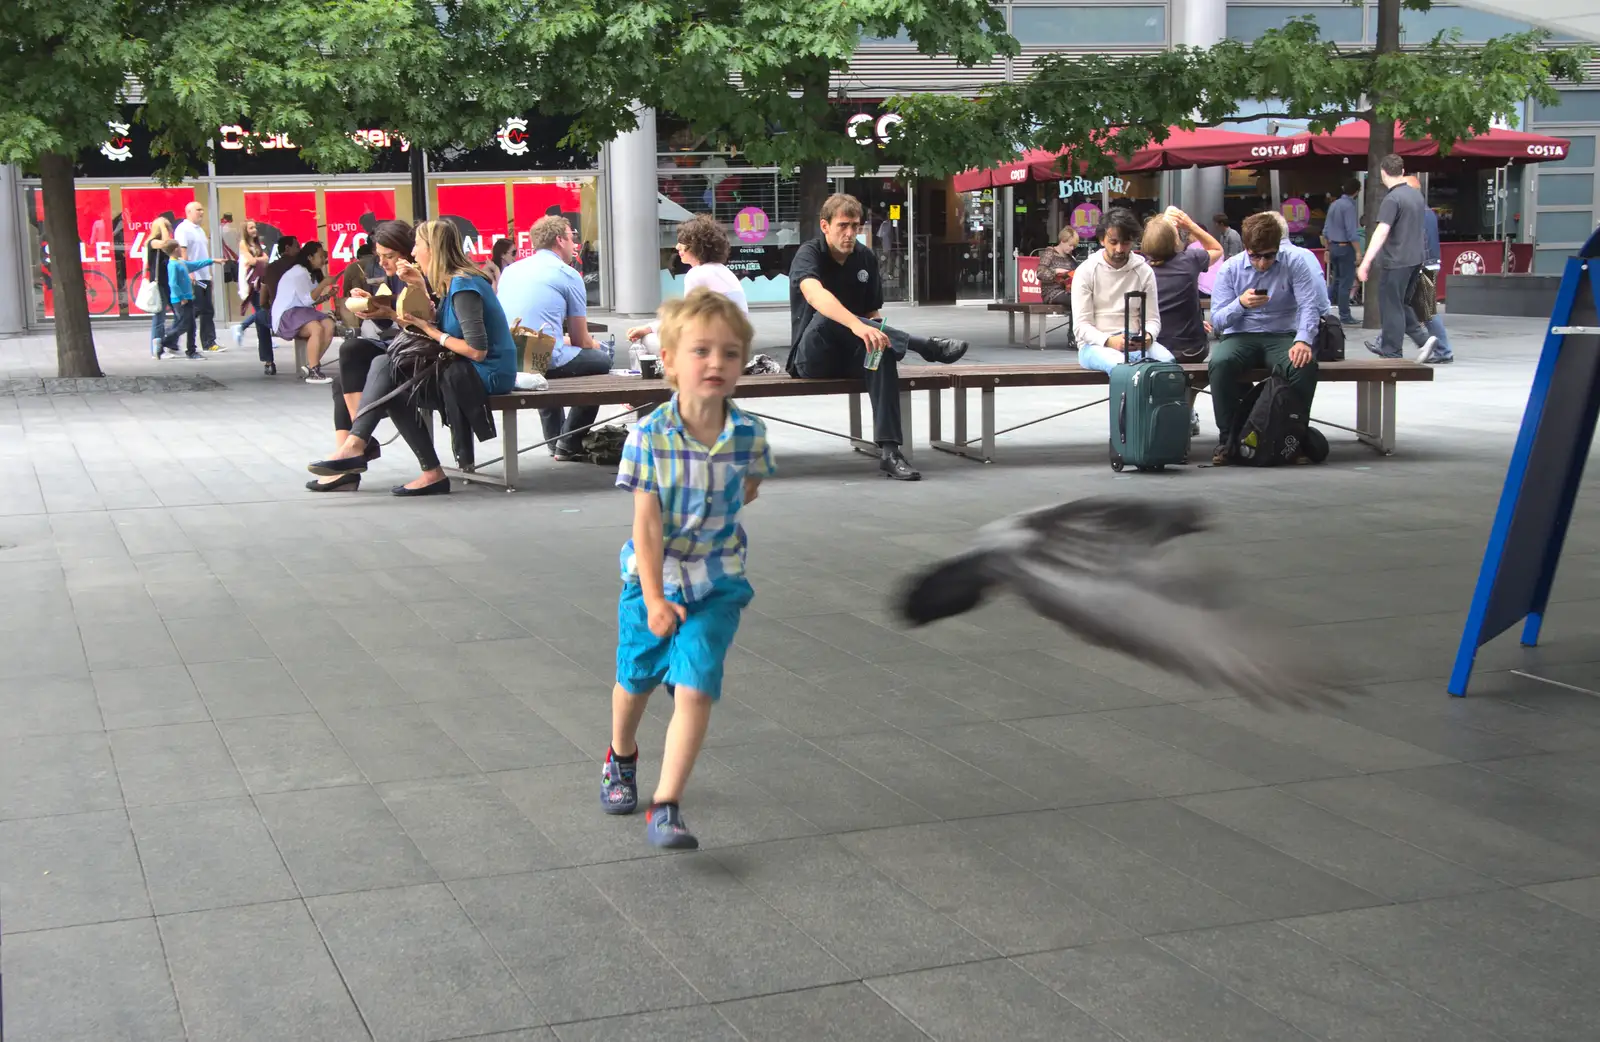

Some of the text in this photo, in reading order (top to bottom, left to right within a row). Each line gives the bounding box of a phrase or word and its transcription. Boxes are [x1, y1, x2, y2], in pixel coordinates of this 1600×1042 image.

[1251, 145, 1288, 157] COSTA
[1527, 144, 1564, 156] COSTA
[128, 222, 142, 231] UP
[331, 223, 357, 232] UP TO
[1458, 252, 1480, 264] COSTA
